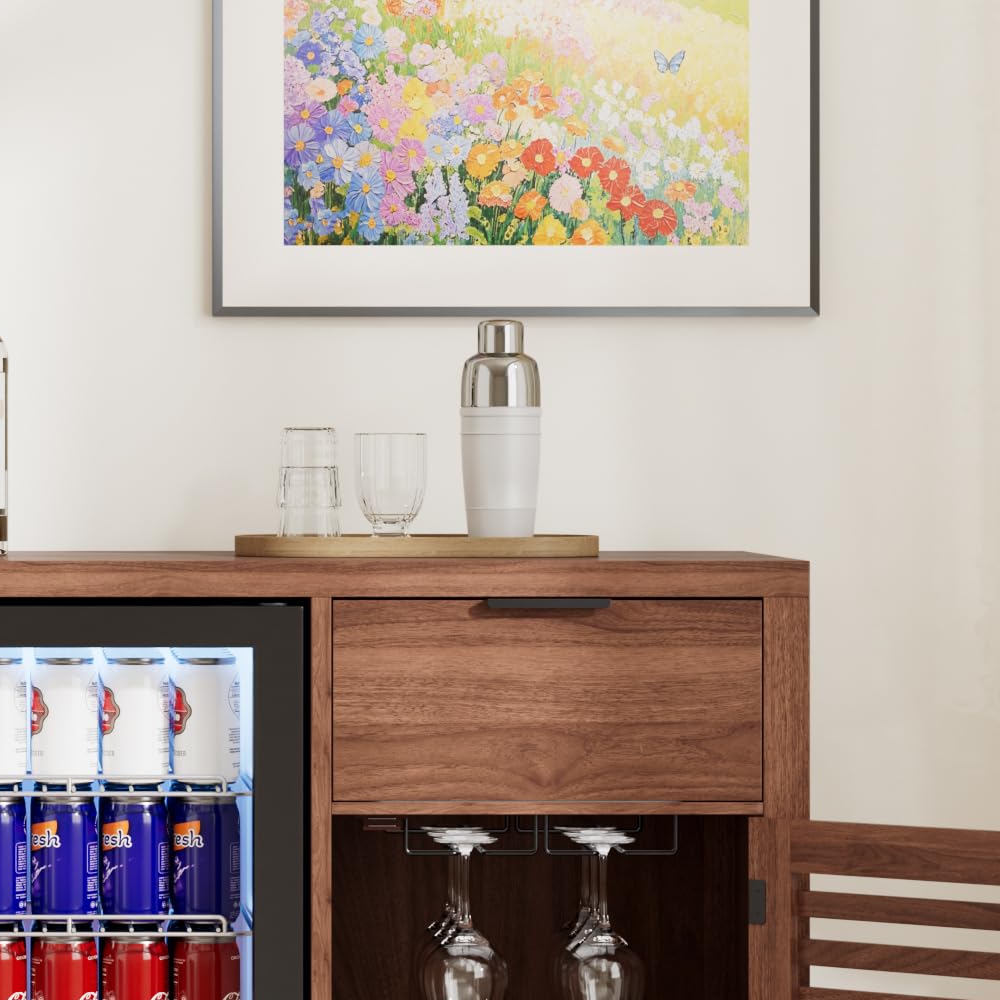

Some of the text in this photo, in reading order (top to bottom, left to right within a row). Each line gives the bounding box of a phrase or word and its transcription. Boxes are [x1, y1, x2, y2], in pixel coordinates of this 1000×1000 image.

[31, 829, 60, 848] esh
[102, 829, 131, 848] esh
[173, 829, 203, 848] esh
